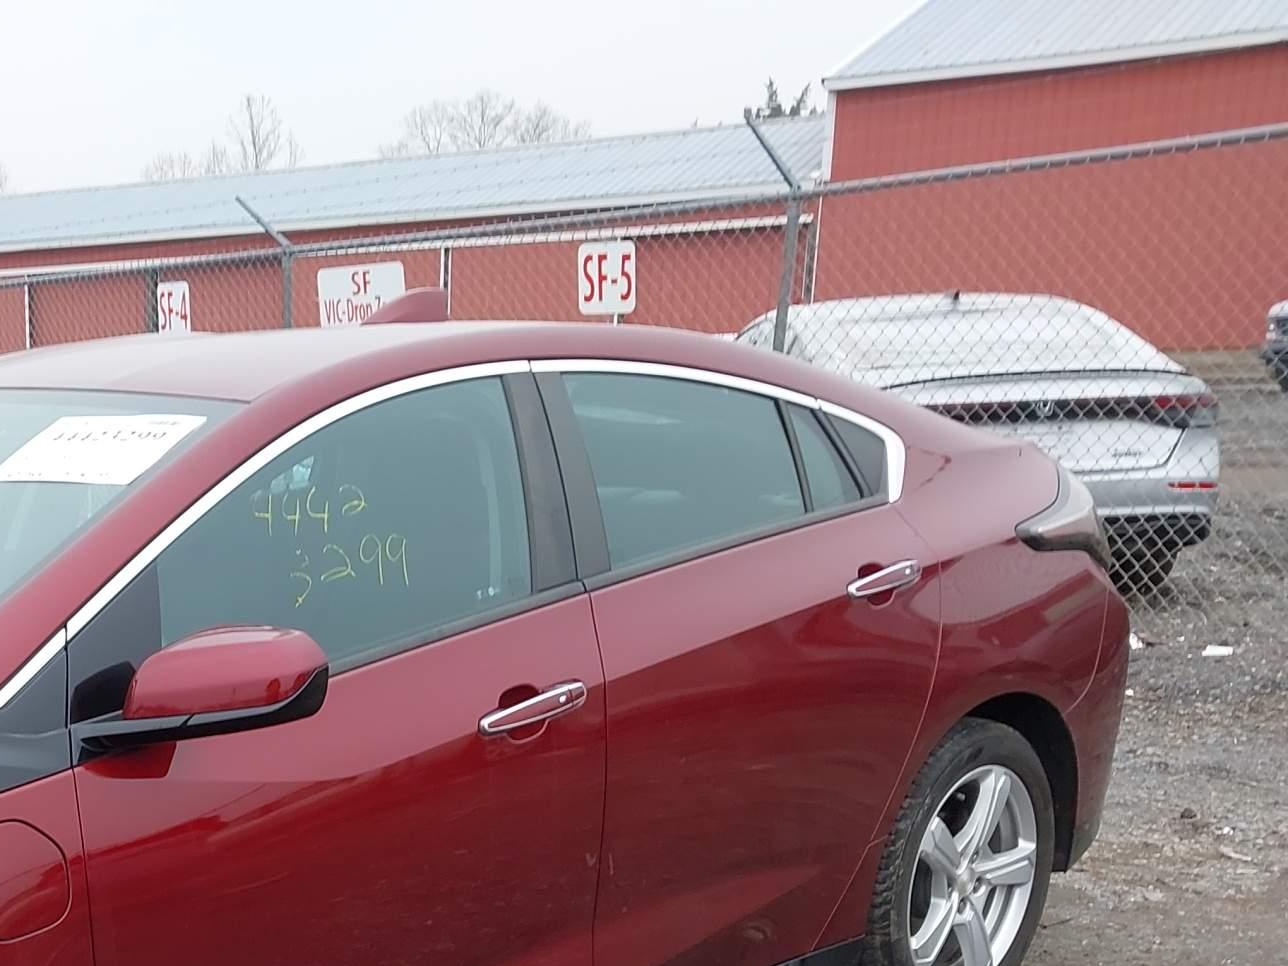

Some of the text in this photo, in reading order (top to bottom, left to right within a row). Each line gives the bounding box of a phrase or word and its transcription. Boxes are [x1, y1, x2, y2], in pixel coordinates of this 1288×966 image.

[351, 270, 371, 296] SF
[583, 254, 632, 302] SF-5
[159, 291, 188, 330] SF-4
[251, 484, 368, 537] 4442
[288, 532, 410, 609] 3299
